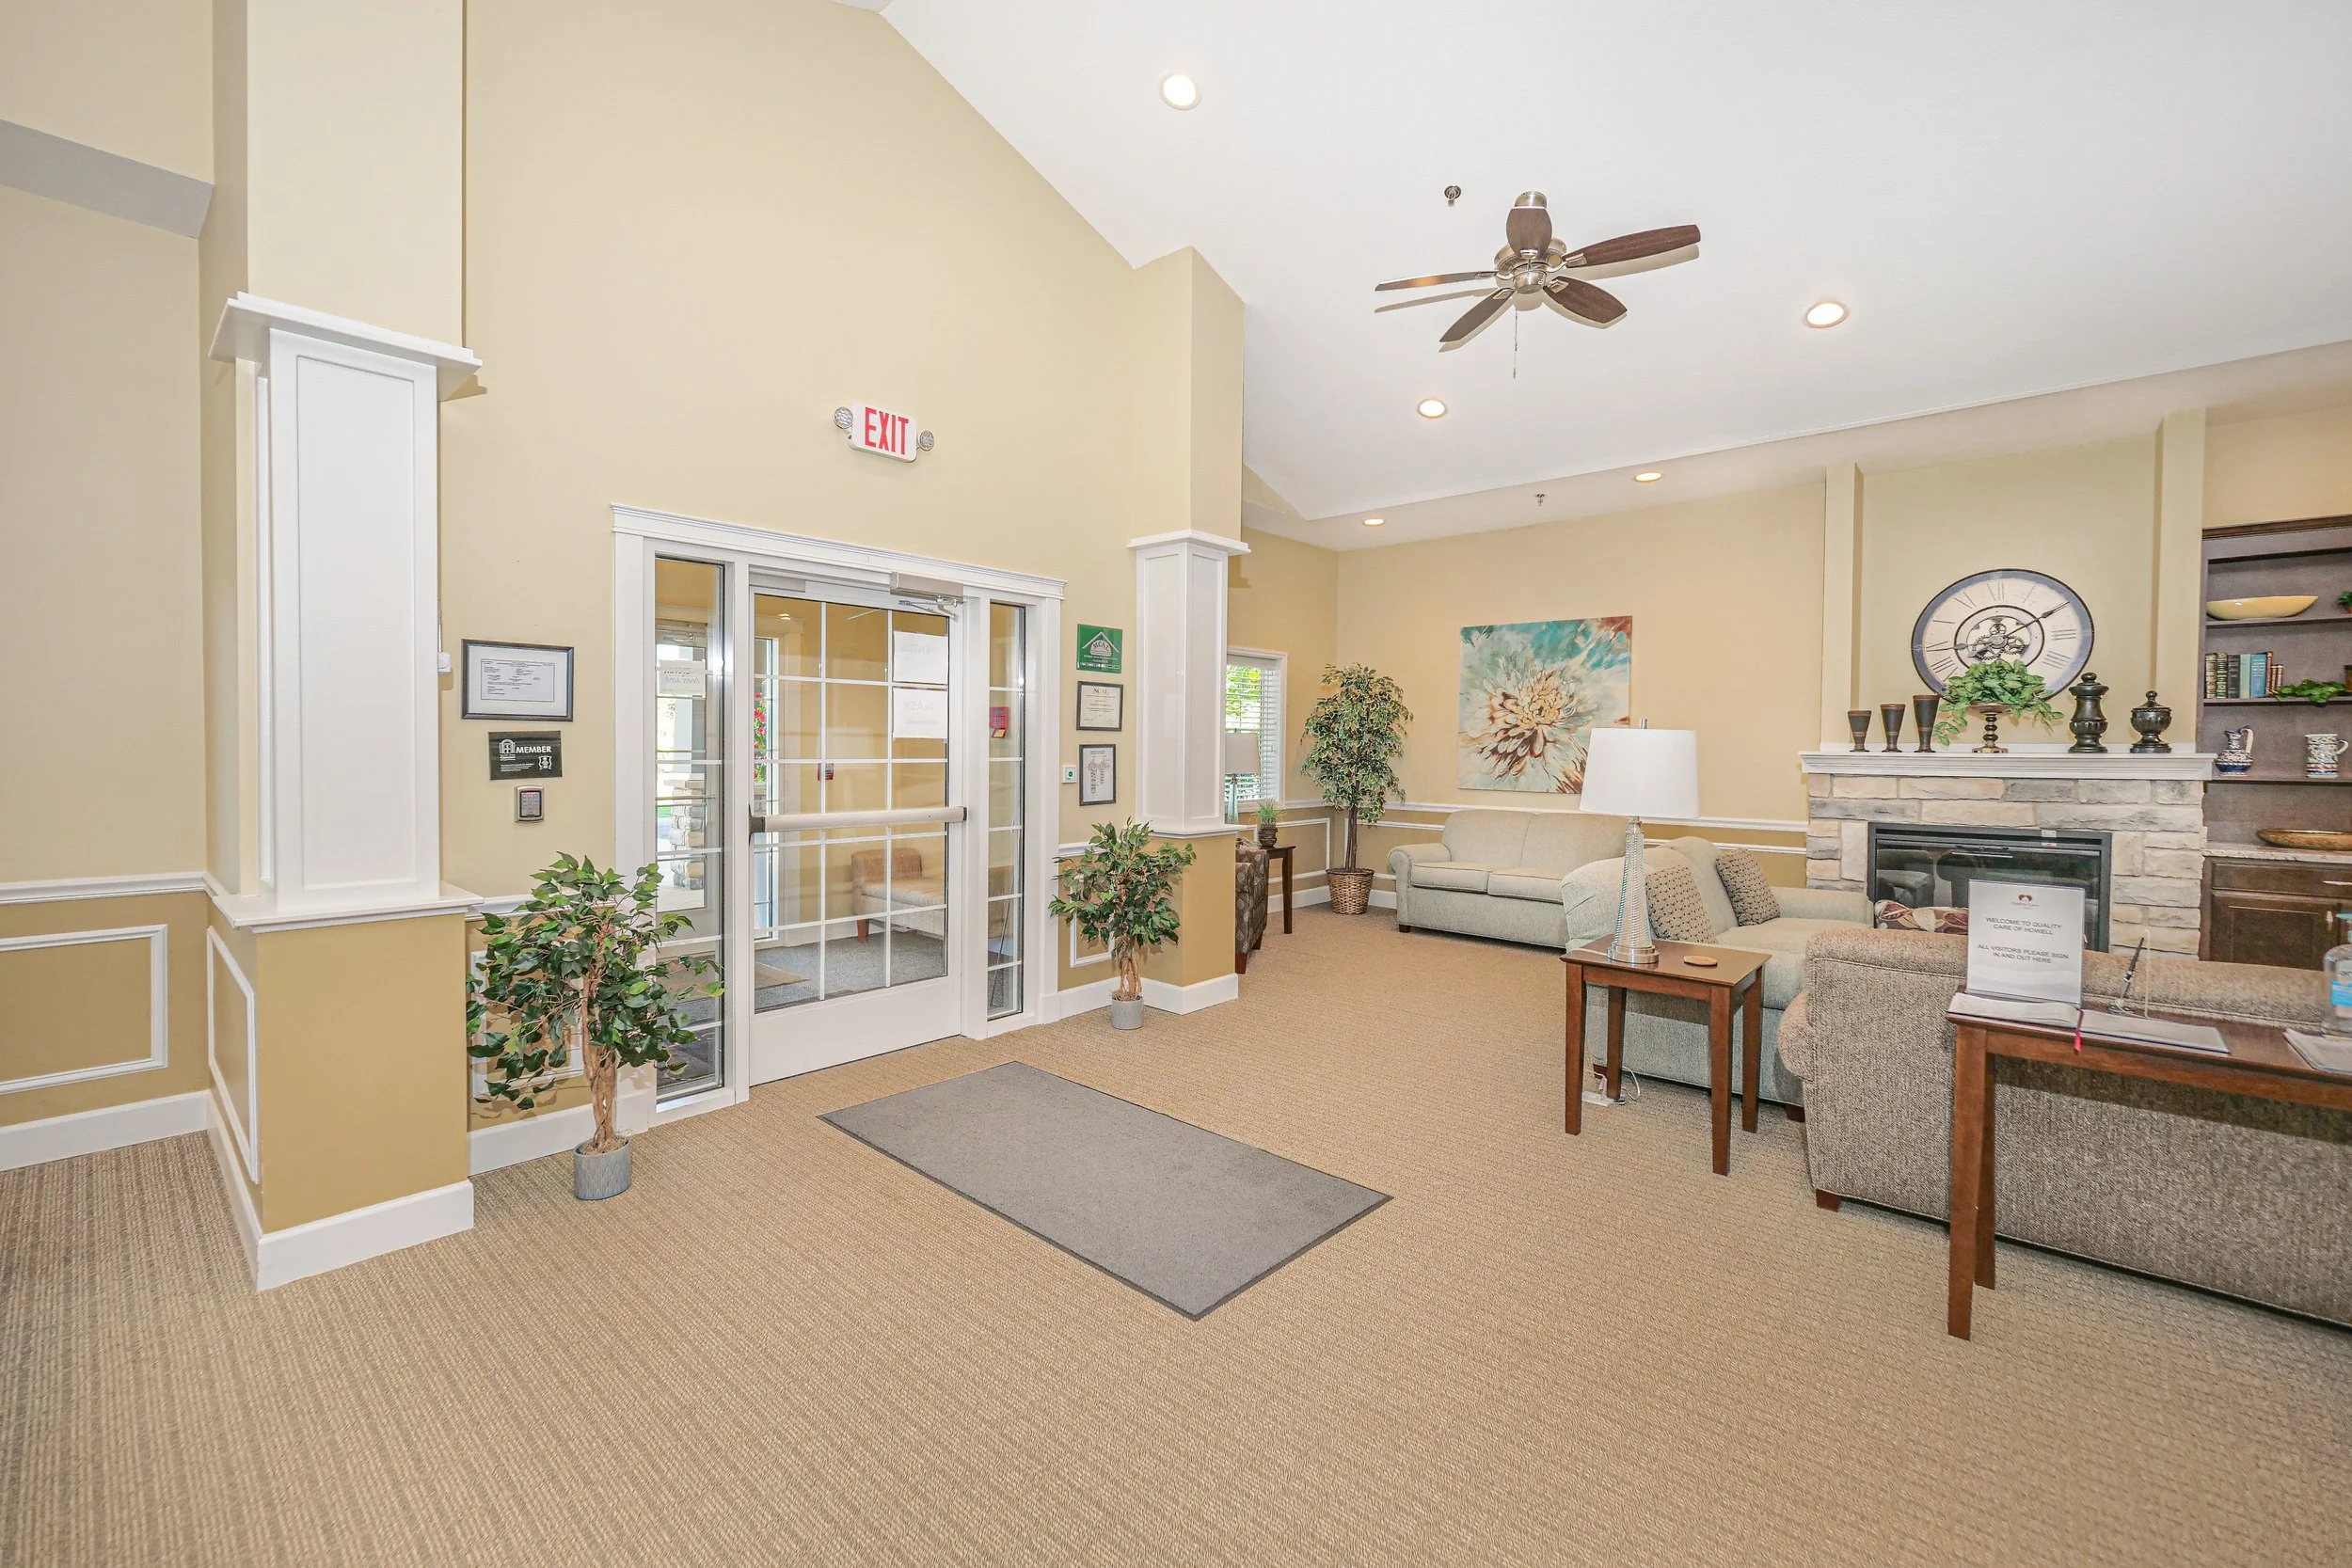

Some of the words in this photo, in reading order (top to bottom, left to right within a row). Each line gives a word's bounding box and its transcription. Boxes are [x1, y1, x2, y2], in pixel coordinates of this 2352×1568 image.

[865, 406, 910, 455] EXIT
[516, 745, 552, 753] MEMBER
[2023, 948, 2049, 957] PLEASE
